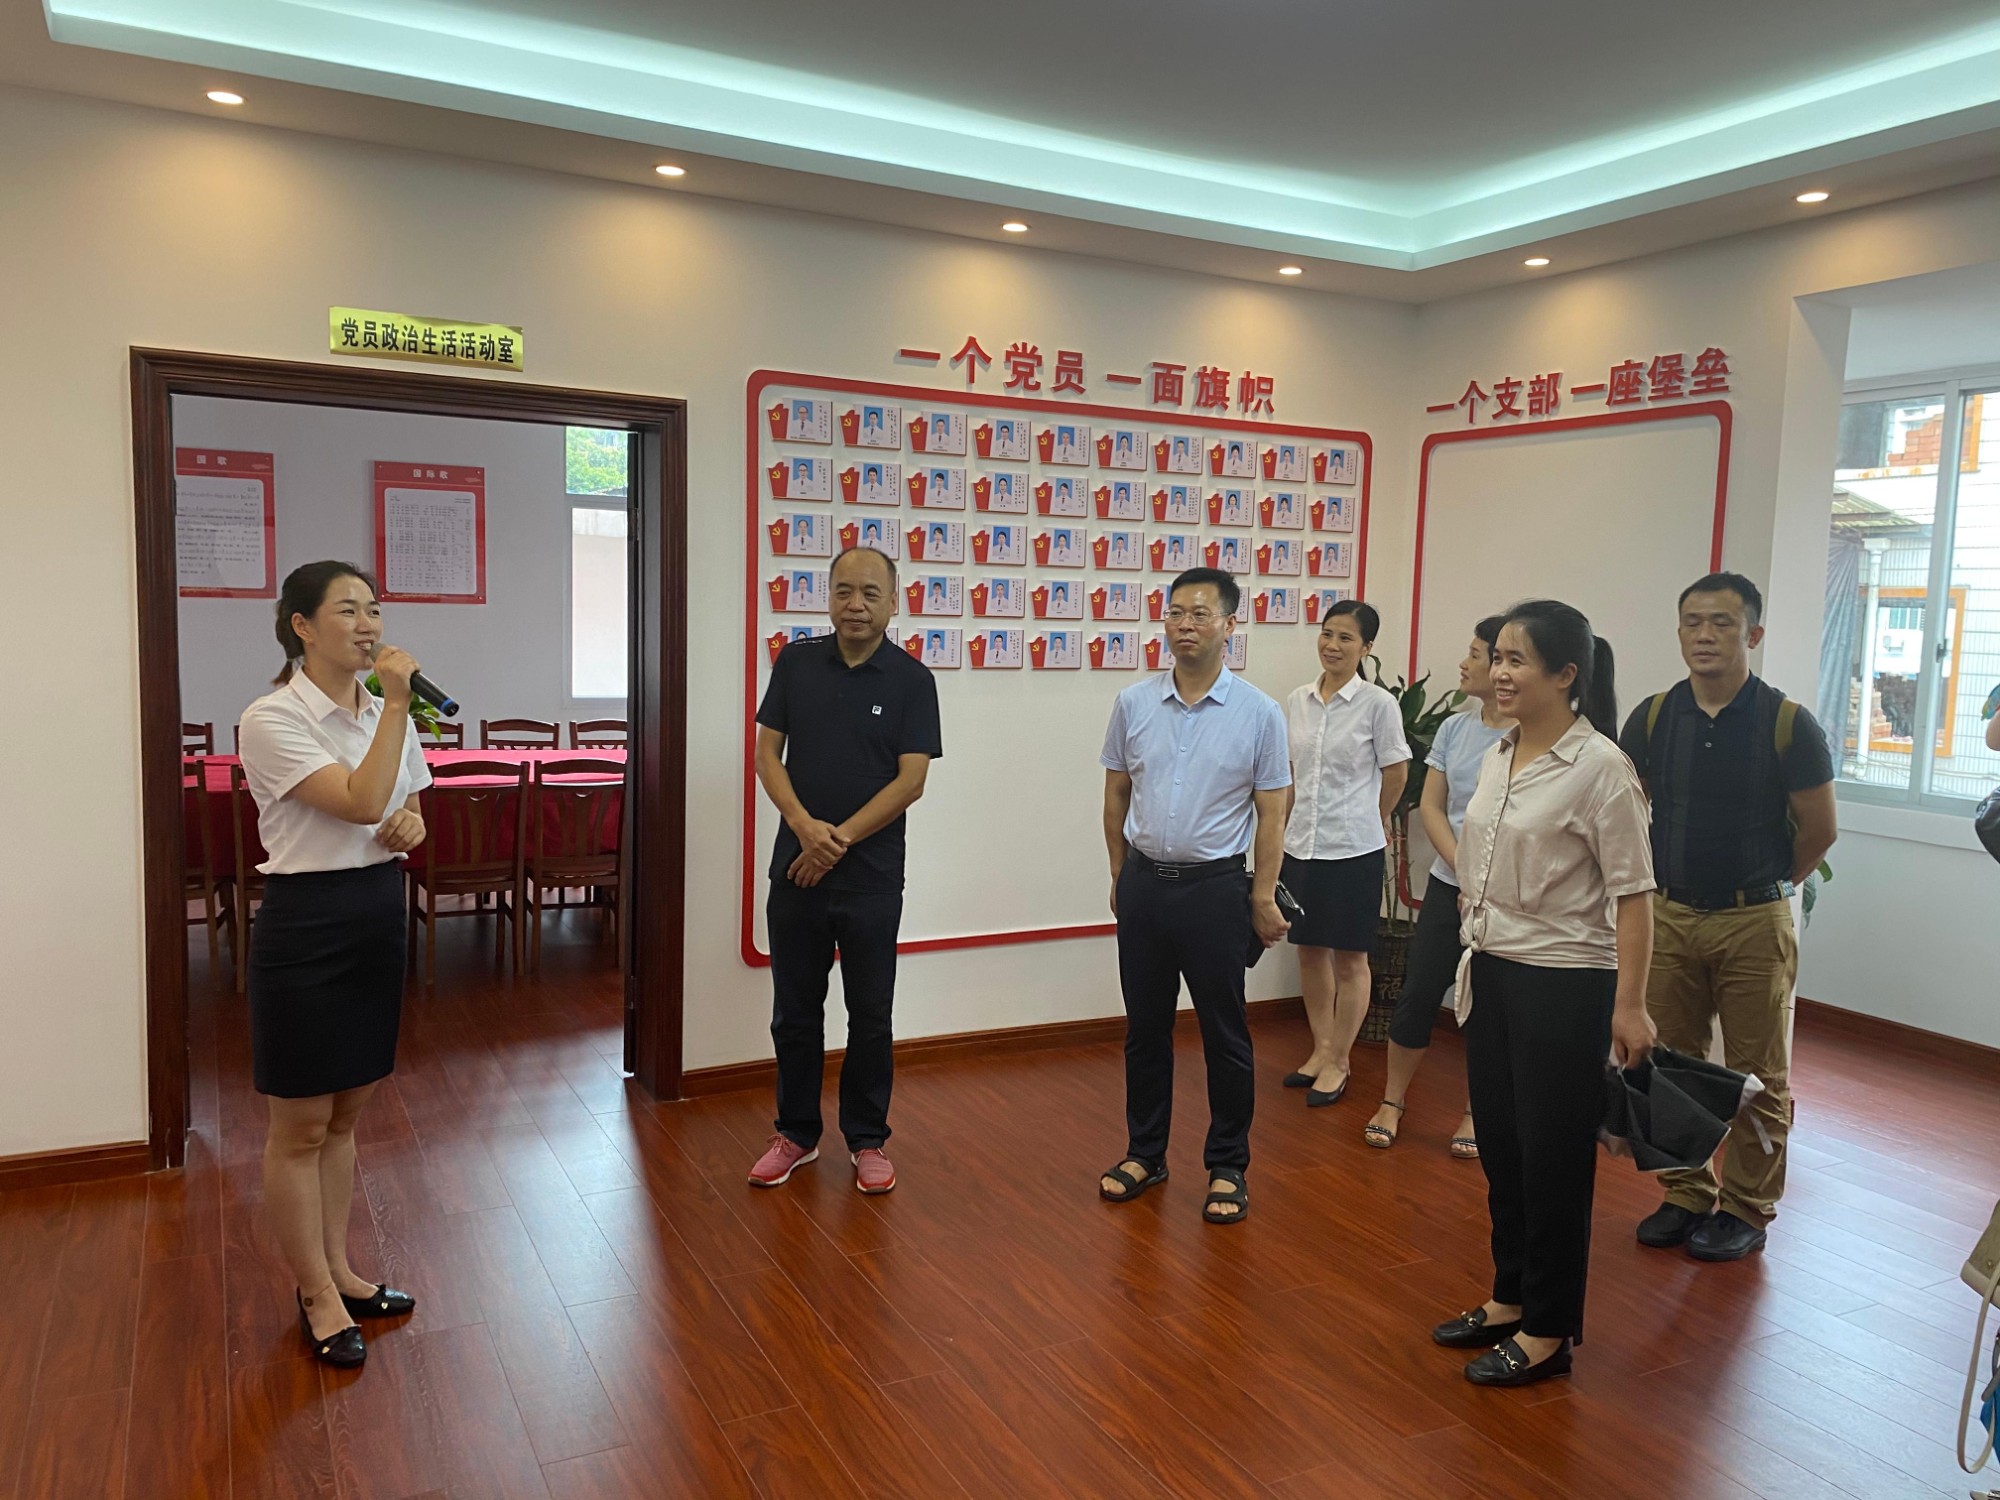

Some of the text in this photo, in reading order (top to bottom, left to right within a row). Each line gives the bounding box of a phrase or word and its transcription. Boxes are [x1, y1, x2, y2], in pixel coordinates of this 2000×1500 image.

[341, 317, 514, 364] 党员政治生活活动室
[900, 335, 1275, 415] 一个党员 一面旗帜
